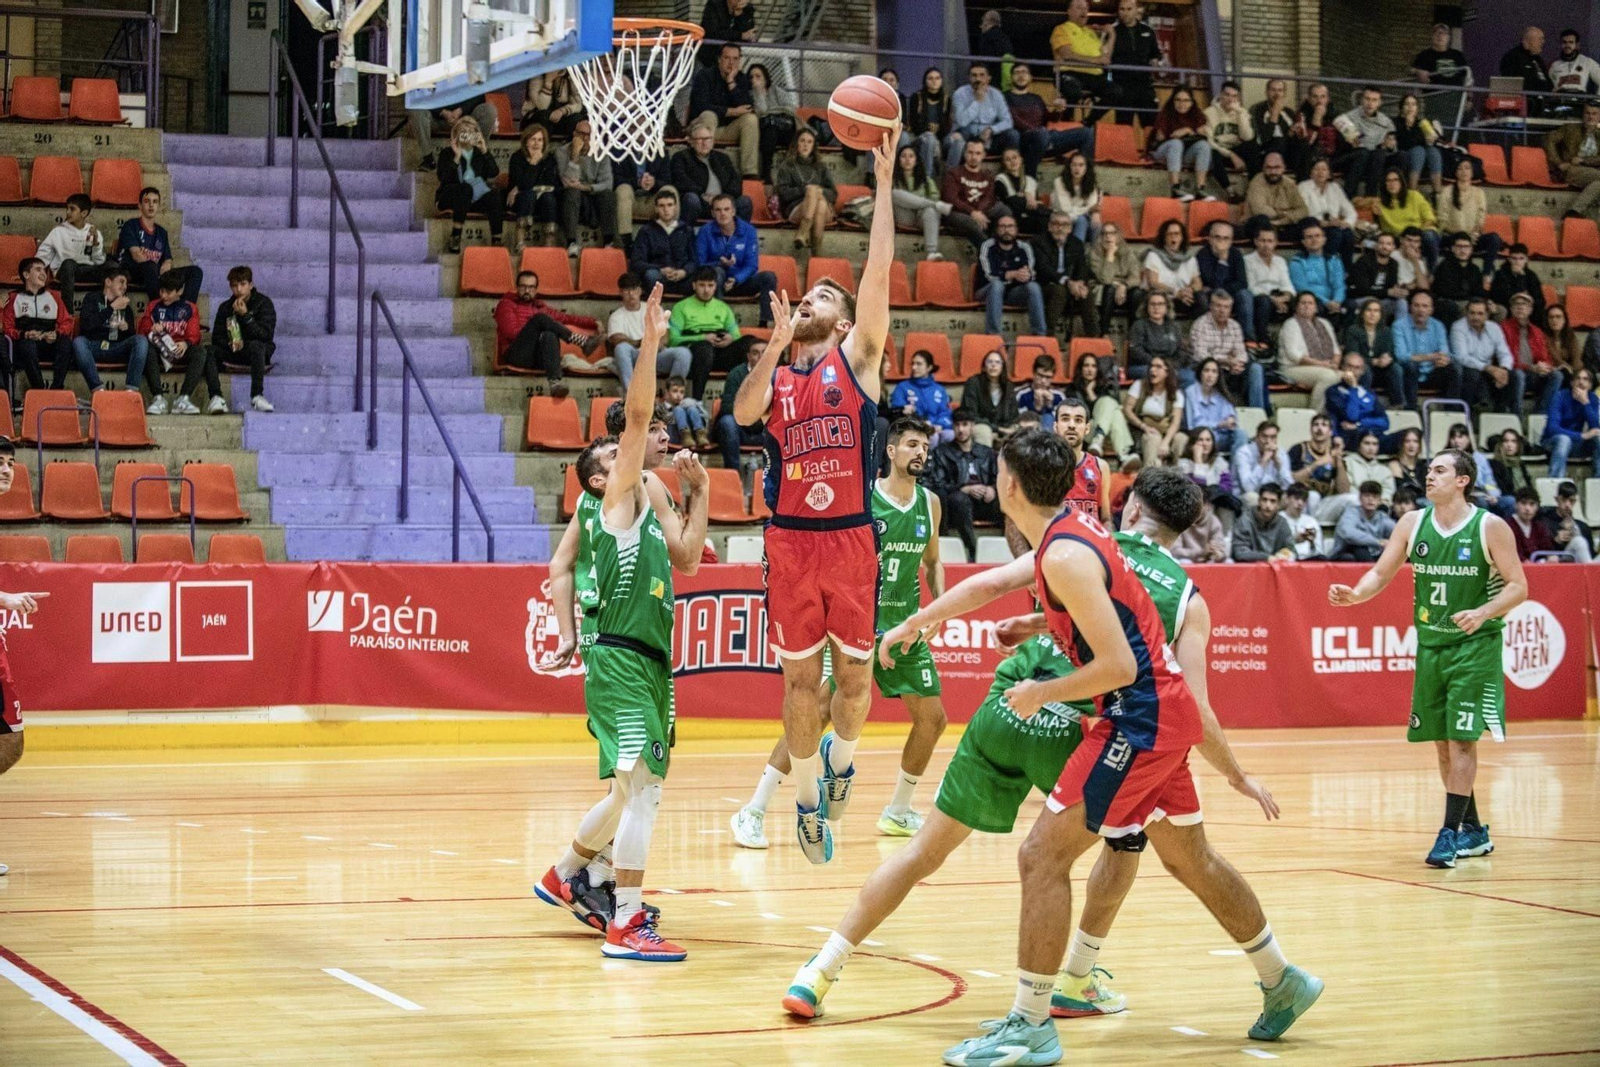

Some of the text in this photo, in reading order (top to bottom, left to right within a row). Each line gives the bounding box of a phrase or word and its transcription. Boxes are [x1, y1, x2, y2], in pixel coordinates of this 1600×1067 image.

[34, 133, 111, 146] 20 21
[162, 383, 178, 394] 21
[780, 396, 797, 421] 11
[802, 456, 840, 477] Jaén
[886, 557, 900, 582] 9
[1426, 565, 1479, 576] ANDUJAR
[1430, 581, 1448, 606] 21
[100, 611, 162, 633] UNED
[202, 613, 227, 629] JAÉN
[350, 595, 437, 635] Jaén
[1252, 626, 1268, 638] de
[350, 633, 469, 653] PARAÍSO INTERIOR
[1211, 642, 1268, 655] servicios
[1313, 659, 1383, 674] CLIMBING
[921, 668, 933, 687] 9
[1455, 711, 1475, 731] 21
